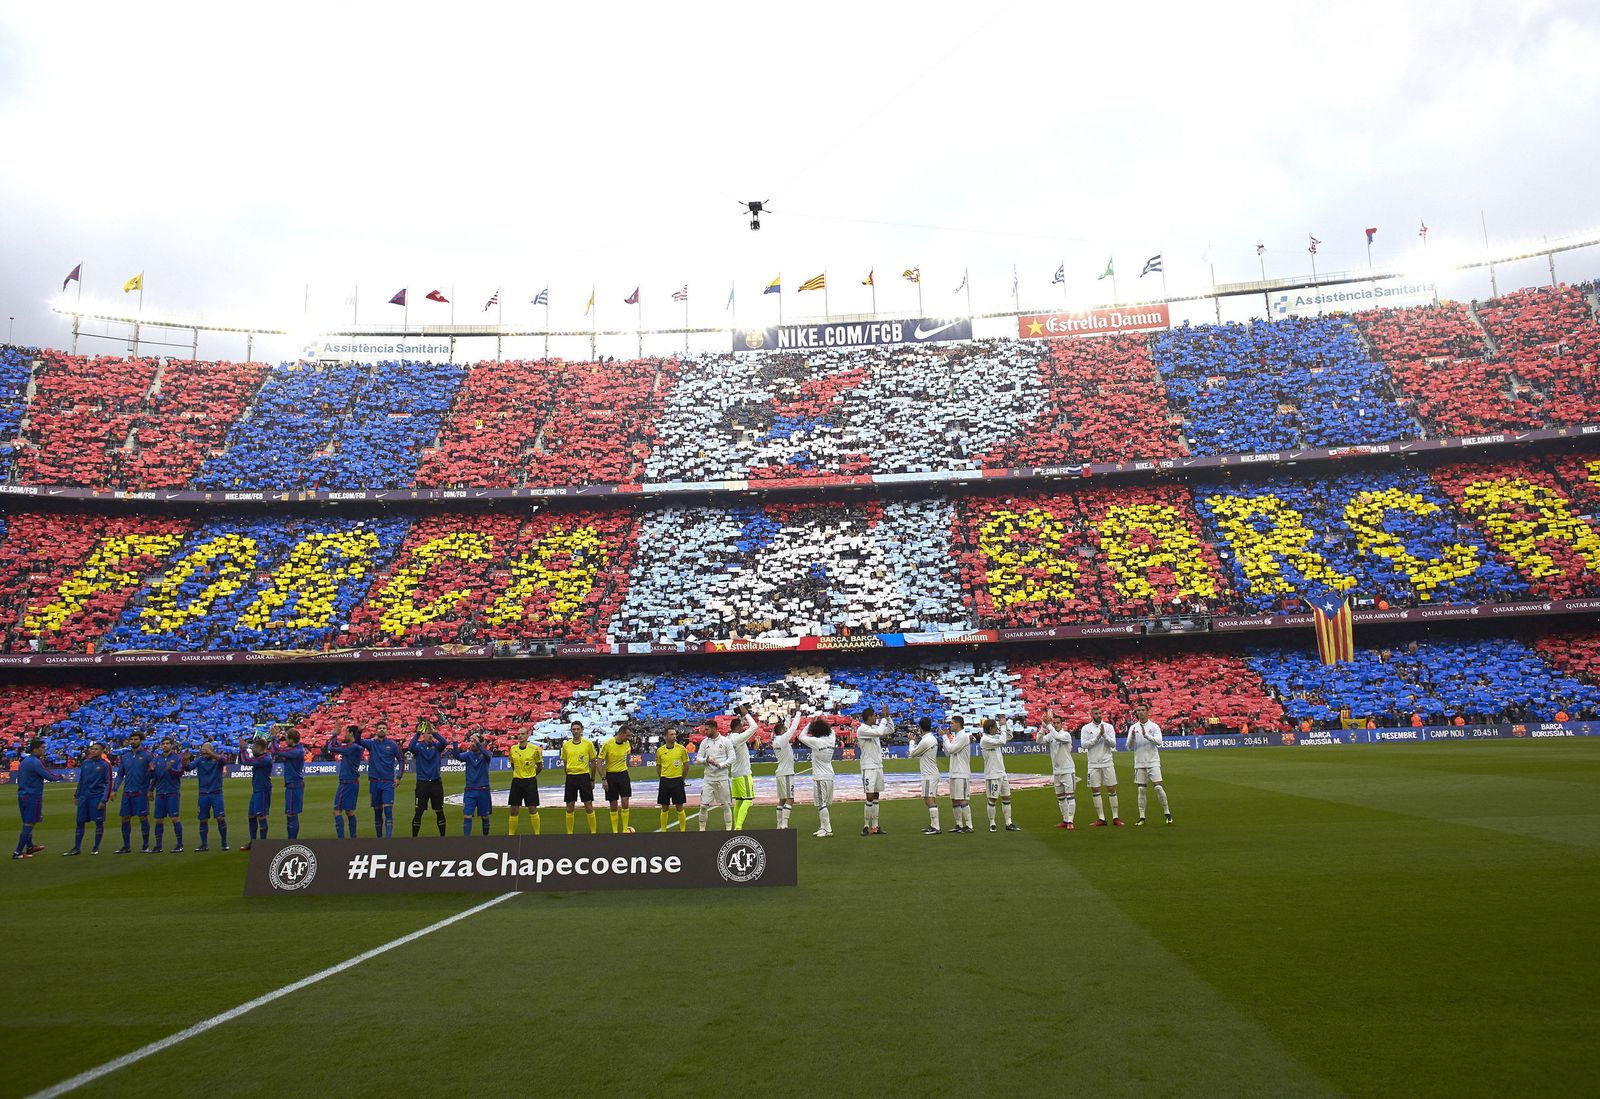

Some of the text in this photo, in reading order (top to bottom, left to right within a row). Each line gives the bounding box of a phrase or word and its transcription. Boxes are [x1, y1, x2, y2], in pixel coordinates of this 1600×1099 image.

[1295, 289, 1373, 307] Assistència
[1046, 312, 1163, 333] Estrella Damm
[777, 323, 902, 348] NIKE.COM/FCB
[323, 343, 449, 354] Assistència Sanitària
[1461, 436, 1504, 446] NIKE.COM/FCB
[1240, 454, 1280, 462] NIKE.COM/FCB
[1450, 729, 1464, 737] NOU
[1532, 730, 1564, 738] BORUSSIA
[348, 853, 682, 883] #FuerzaChapecoense
